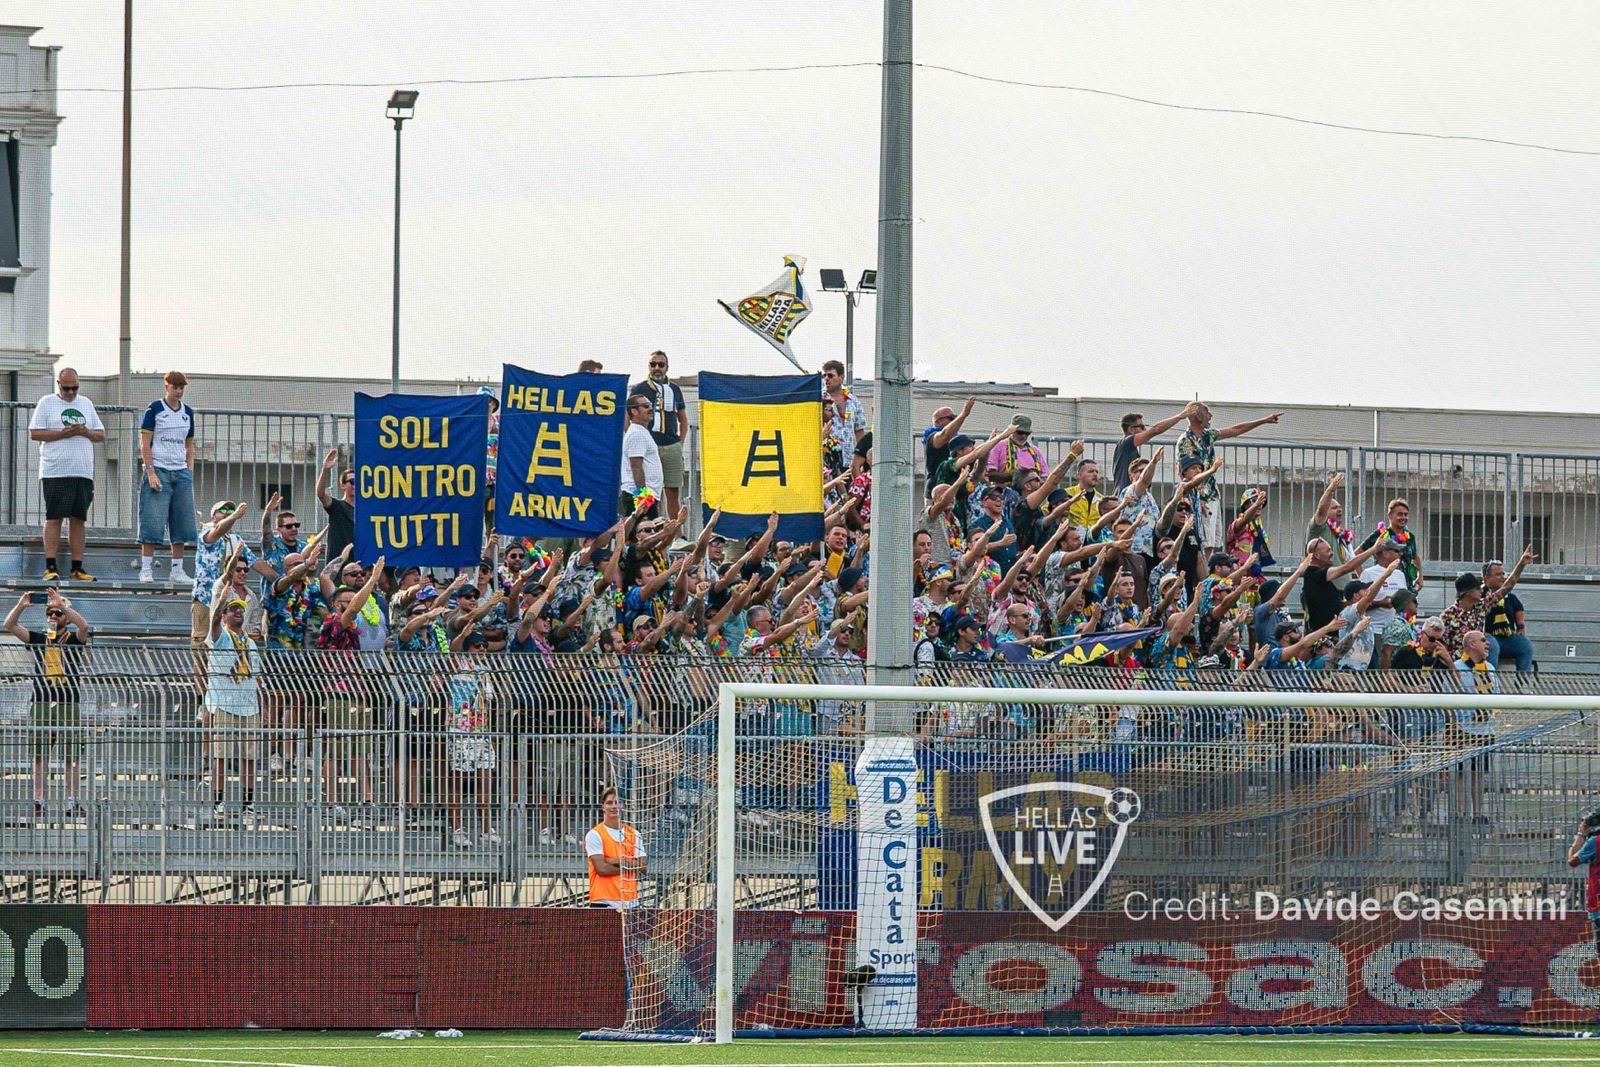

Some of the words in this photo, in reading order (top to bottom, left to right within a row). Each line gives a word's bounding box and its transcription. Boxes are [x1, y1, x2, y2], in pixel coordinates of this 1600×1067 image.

[760, 299, 783, 330] HELLAS
[506, 384, 617, 416] HELLAS
[379, 415, 450, 449] SOLI
[360, 464, 476, 499] CONTRO
[508, 491, 593, 522] ARMY
[369, 512, 460, 549] TUTTI
[1567, 646, 1574, 656] F
[870, 948, 916, 969] Sport
